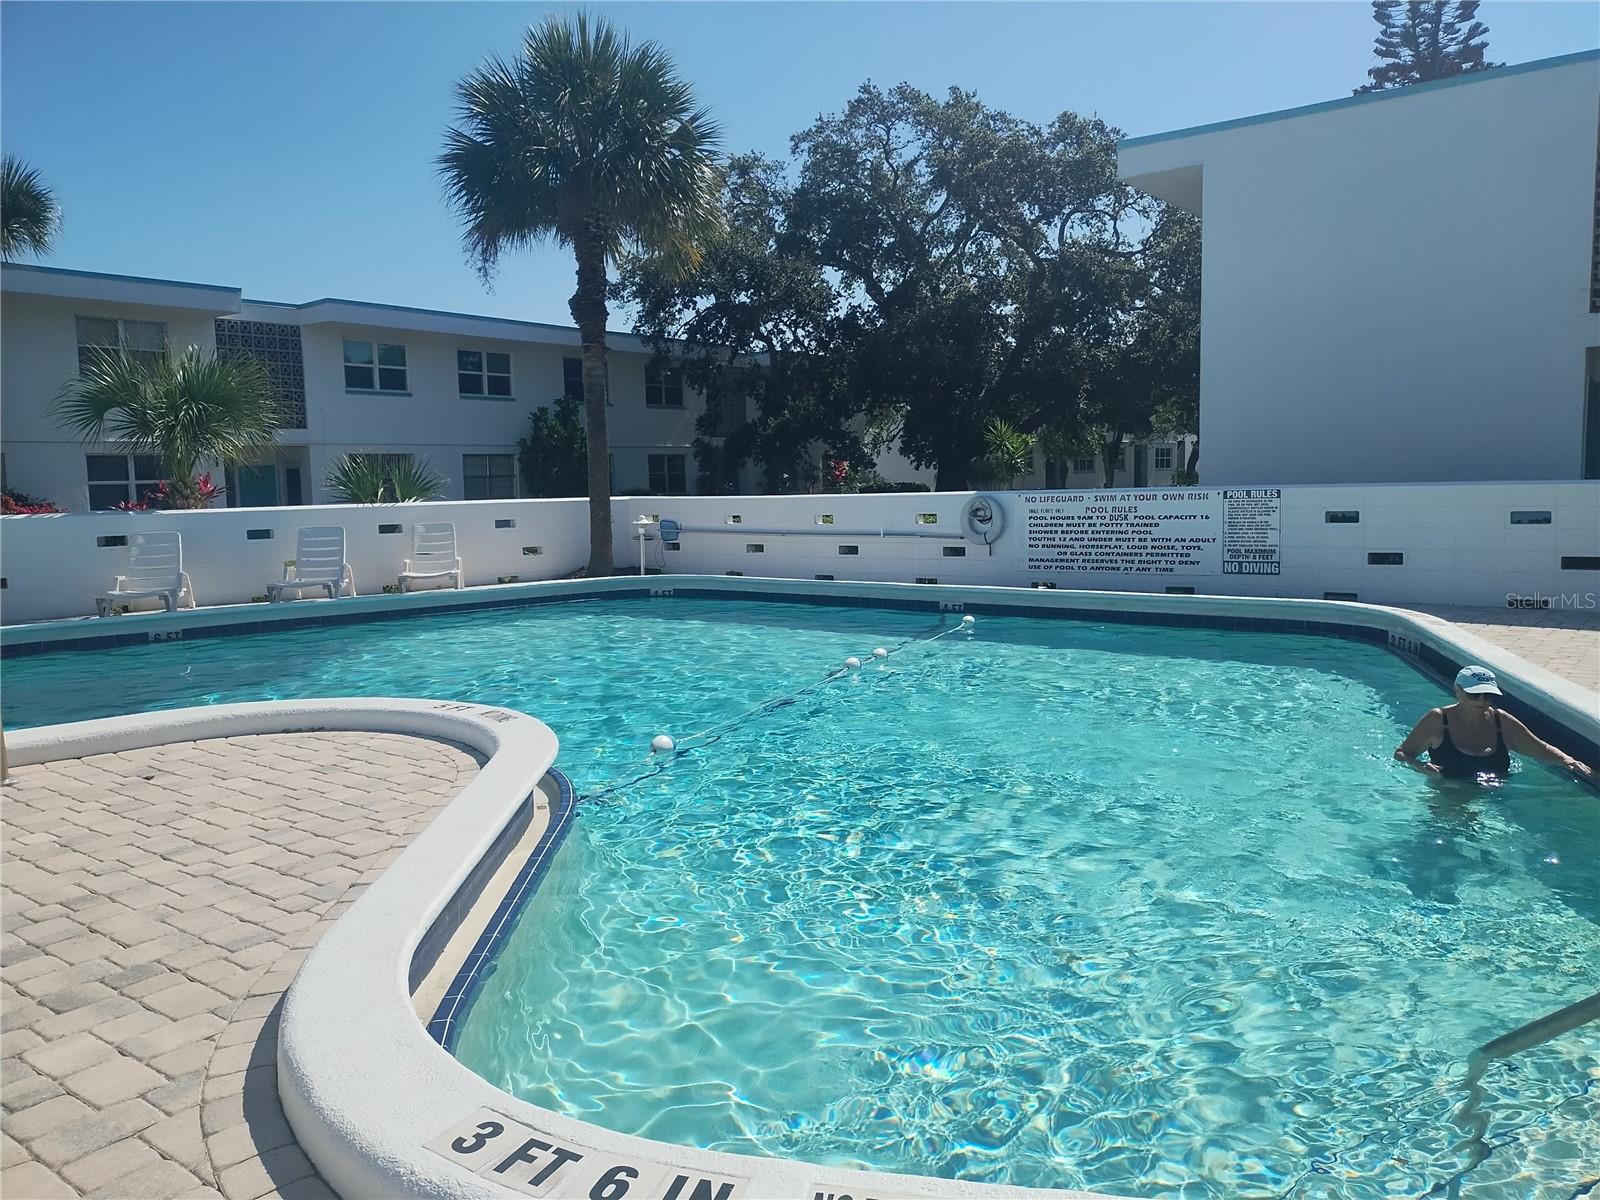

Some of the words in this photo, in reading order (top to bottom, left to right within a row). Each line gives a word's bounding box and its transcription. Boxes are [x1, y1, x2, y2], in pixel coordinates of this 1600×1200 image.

[1227, 490, 1248, 498] POOL
[1224, 562, 1239, 572] NO
[1242, 562, 1279, 573] DIVING
[451, 1121, 505, 1154] 3
[493, 1137, 584, 1187] FT
[588, 1166, 640, 1200] 6
[662, 1174, 735, 1200] IN
